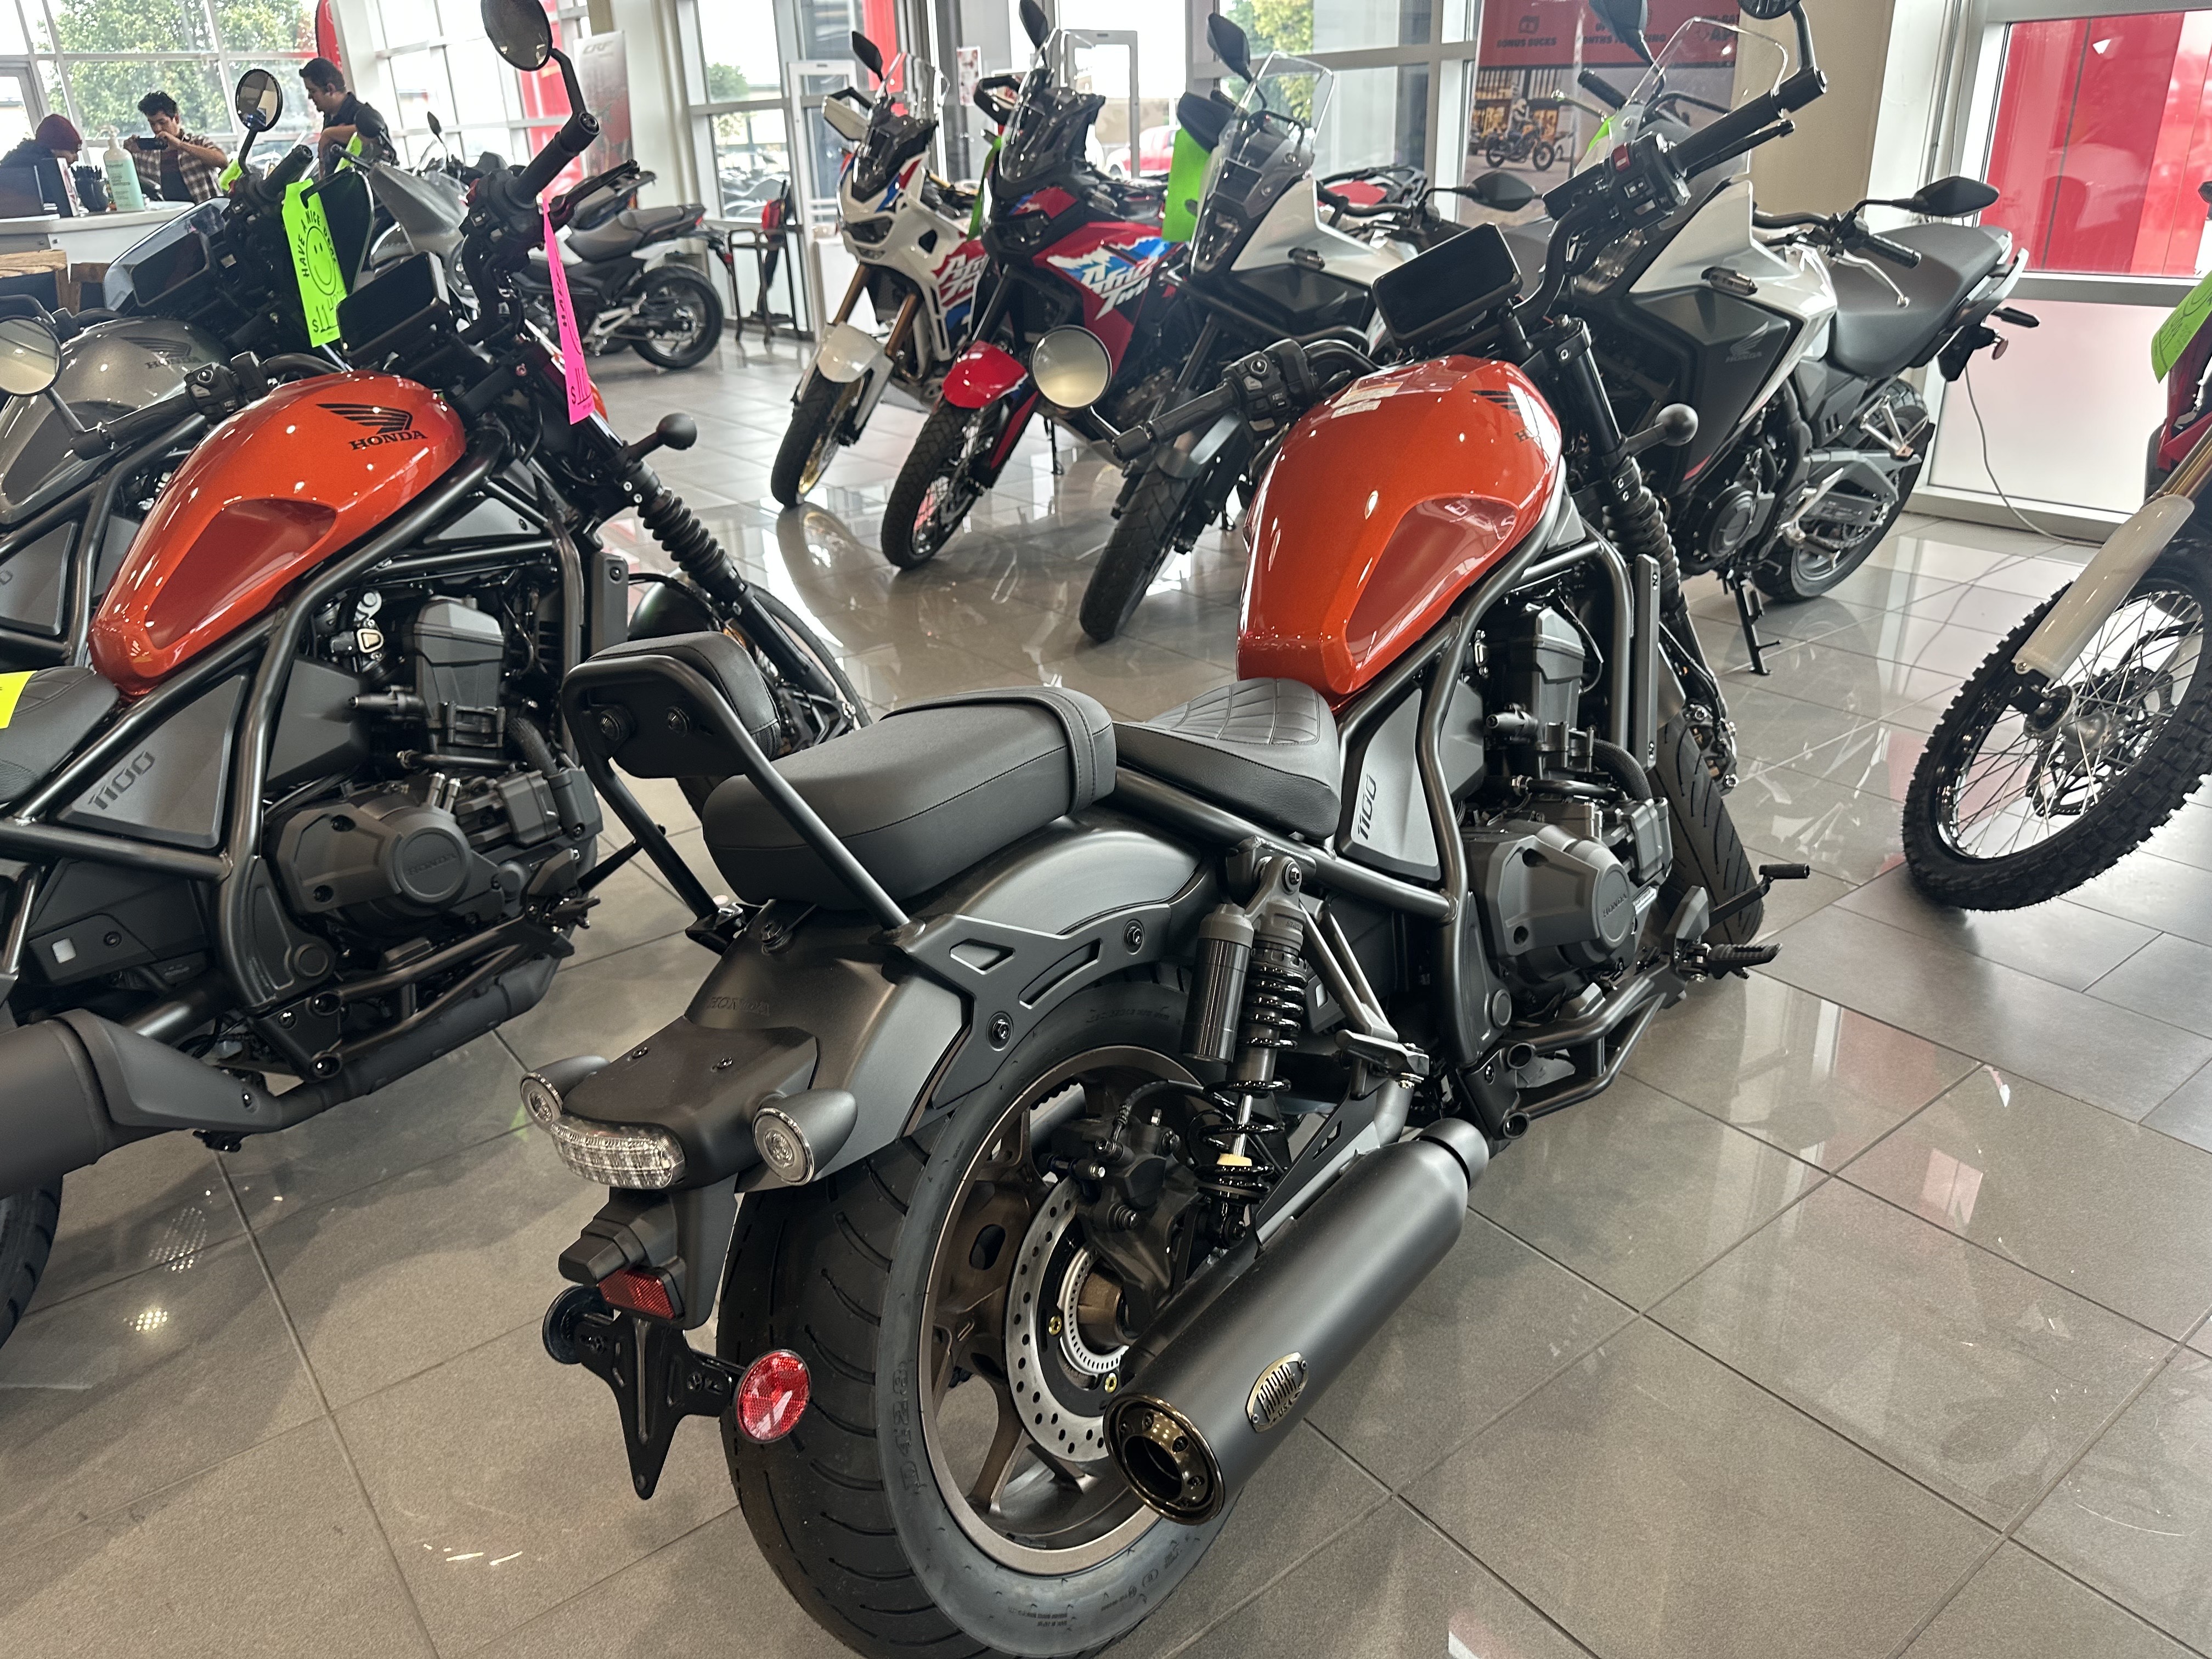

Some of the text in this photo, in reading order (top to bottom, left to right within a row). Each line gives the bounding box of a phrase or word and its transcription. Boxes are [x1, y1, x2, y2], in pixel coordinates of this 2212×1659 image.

[348, 430, 428, 450] HONDA
[88, 750, 155, 810] 1100
[1358, 773, 1376, 840] 1100
[1602, 893, 1627, 918] HONDA
